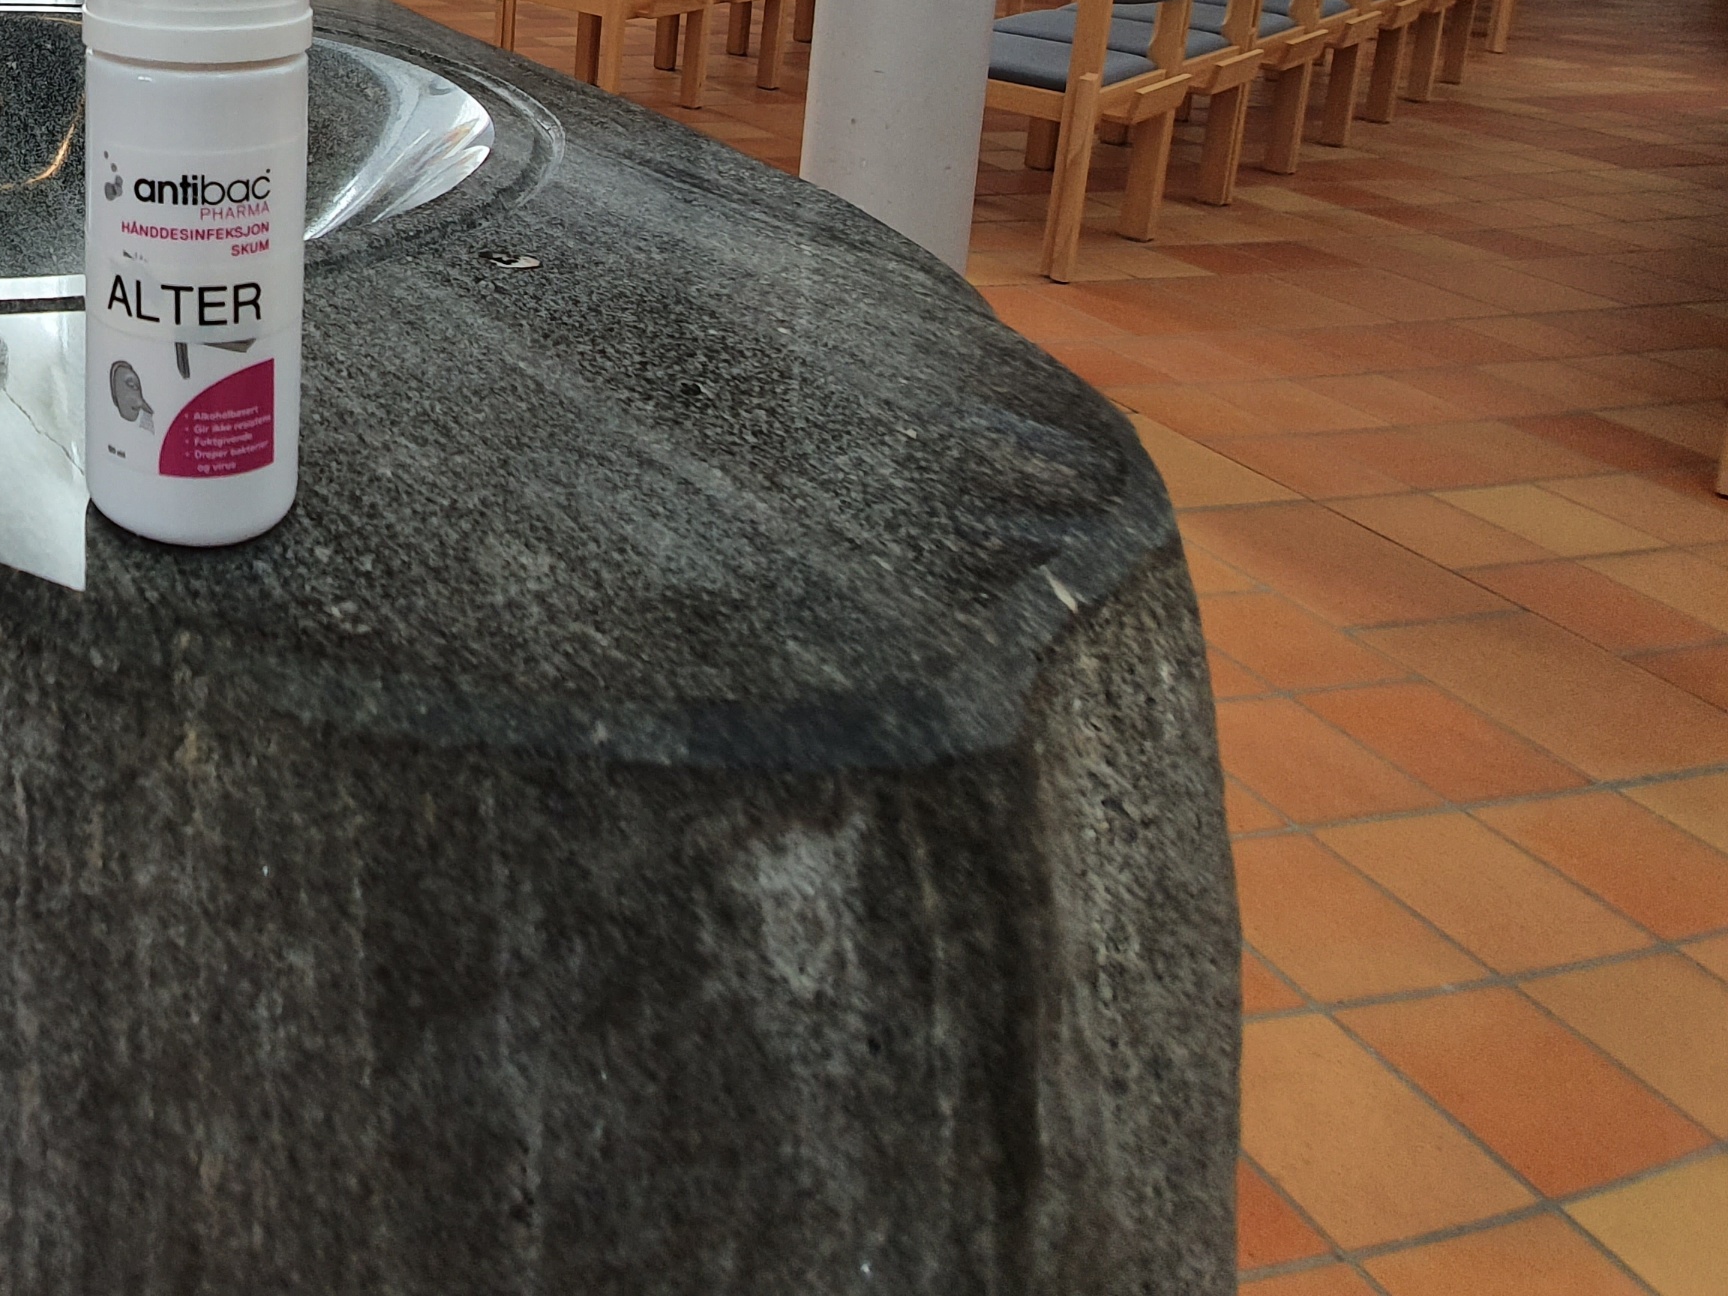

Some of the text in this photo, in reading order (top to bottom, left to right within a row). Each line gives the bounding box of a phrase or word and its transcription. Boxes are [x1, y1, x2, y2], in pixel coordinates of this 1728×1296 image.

[133, 173, 271, 206] antibac
[200, 201, 271, 221] PHARMA
[121, 220, 270, 241] HÅNDDESINFEKSJON
[231, 239, 270, 257] SKUM
[107, 274, 262, 326] ALTER
